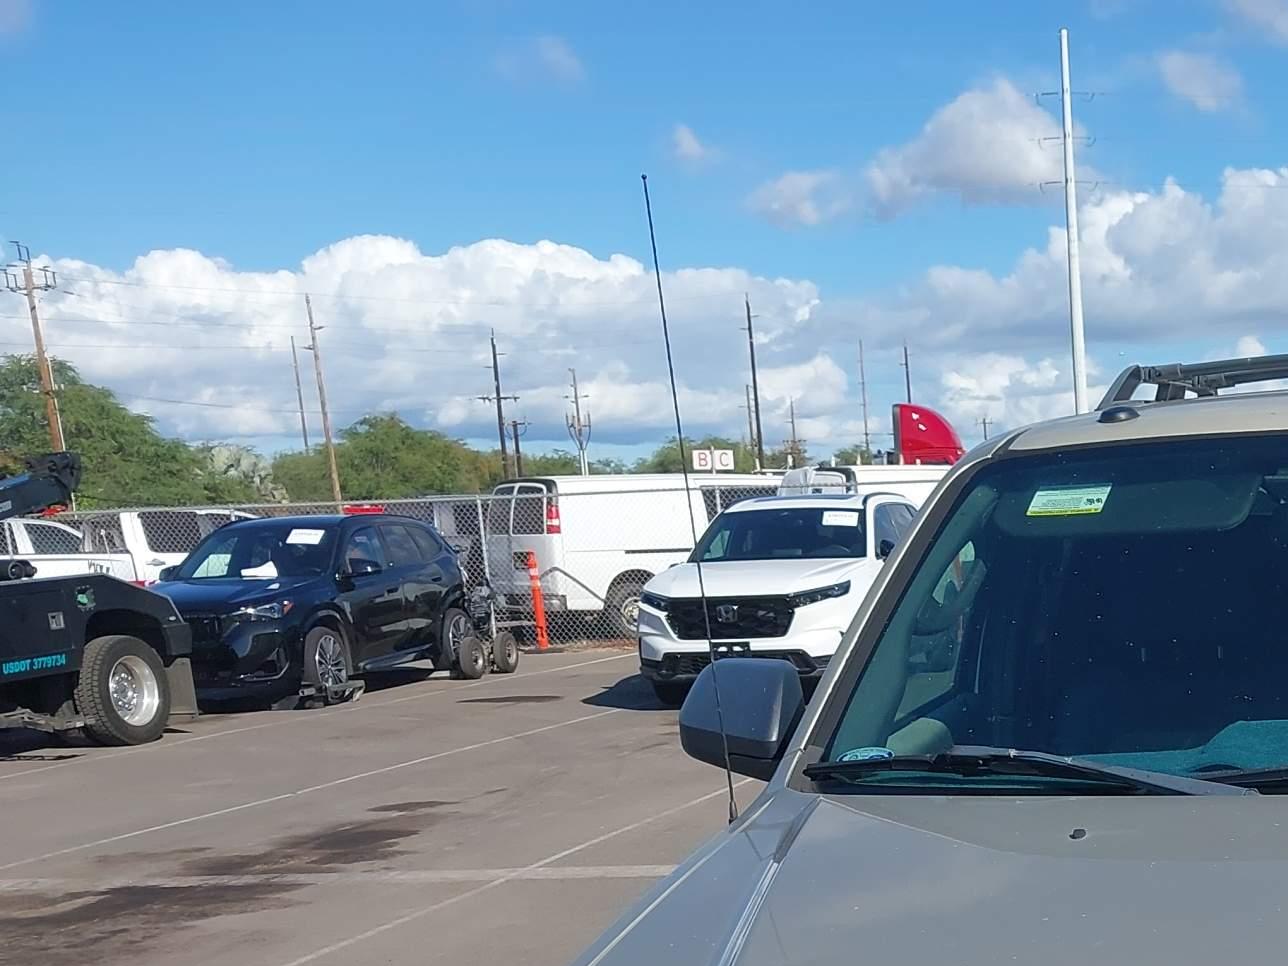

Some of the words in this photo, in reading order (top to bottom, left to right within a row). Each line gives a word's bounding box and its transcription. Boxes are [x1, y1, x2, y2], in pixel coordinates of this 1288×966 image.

[698, 452, 708, 467] B
[719, 451, 730, 467] C
[2, 658, 31, 675] USDOT
[32, 654, 66, 670] 3779734
